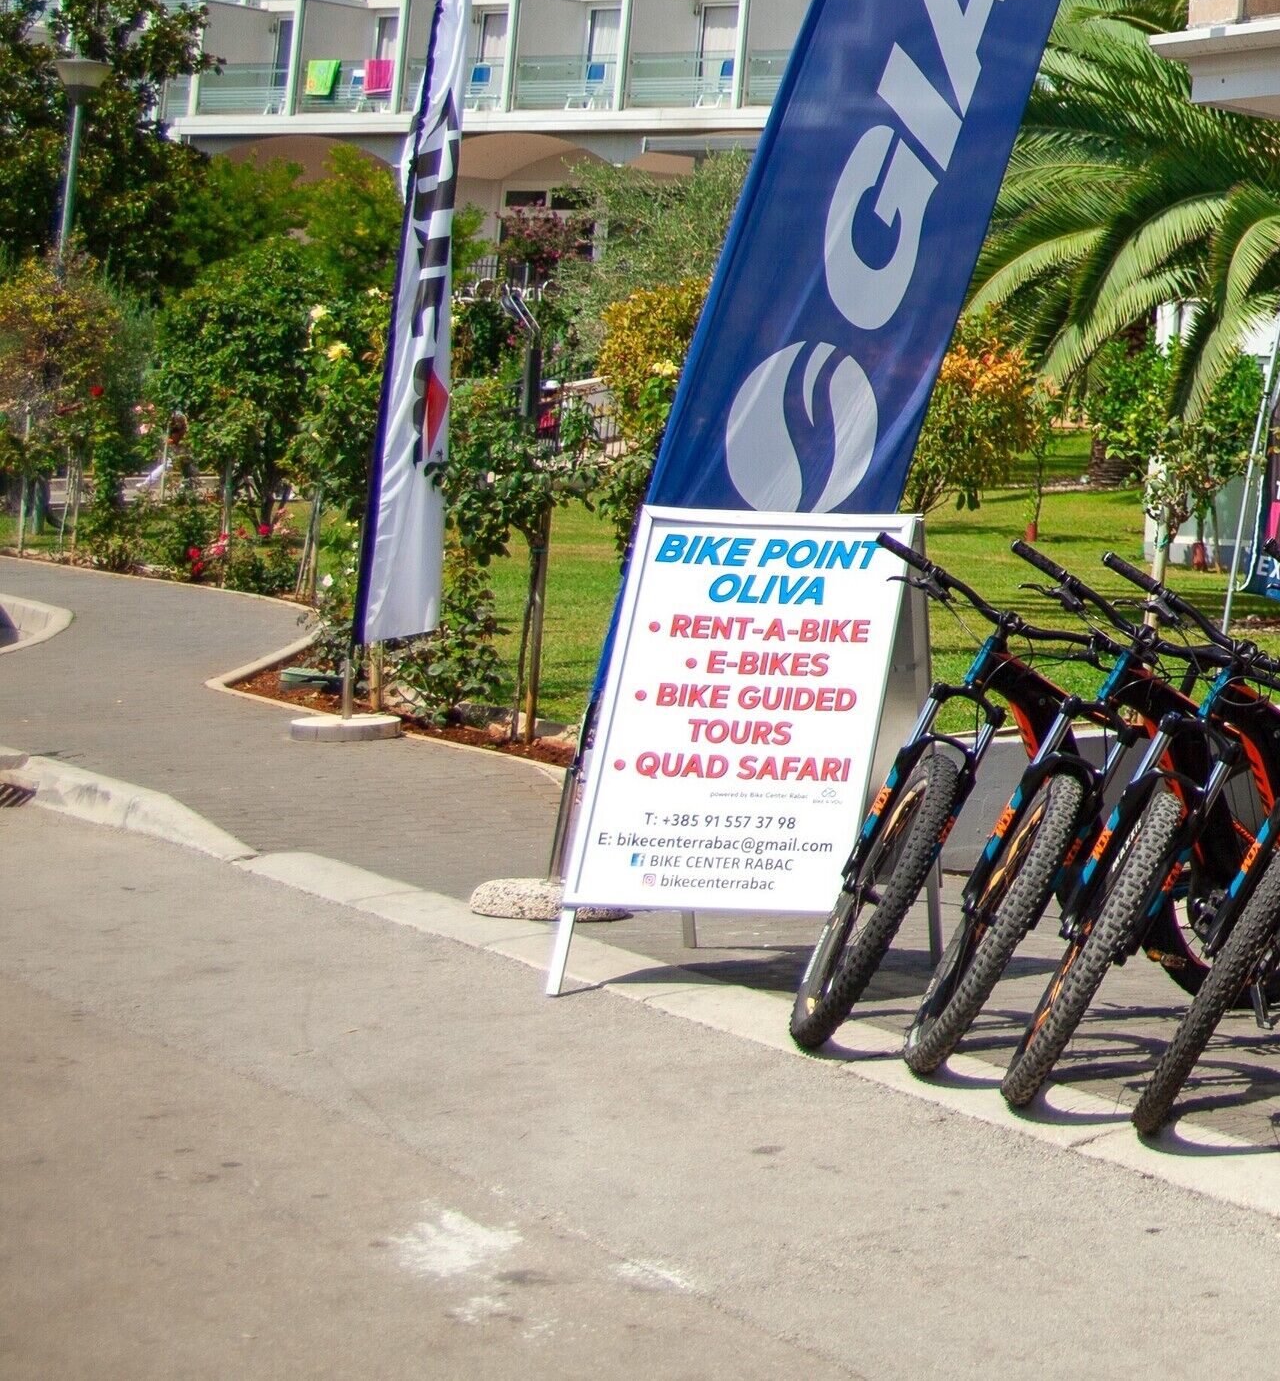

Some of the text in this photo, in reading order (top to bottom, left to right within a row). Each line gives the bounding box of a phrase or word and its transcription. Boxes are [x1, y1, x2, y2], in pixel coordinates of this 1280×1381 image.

[655, 533, 880, 570] BIKE POINT
[708, 573, 826, 605] OLIVA
[669, 614, 871, 644] RENT-A-BIKE
[706, 651, 830, 677] E-BIKES
[655, 683, 858, 712] BIKE GUIDED
[688, 719, 792, 746] TOURS
[635, 751, 852, 783] QUAD SAFARI
[644, 812, 796, 830] T: +385 91 557 37 98
[598, 832, 833, 855] E: bikecenterrabac@gmail.com
[649, 855, 794, 871] BIKE CENTER RABAC
[660, 874, 775, 891] bikecenterrabac
